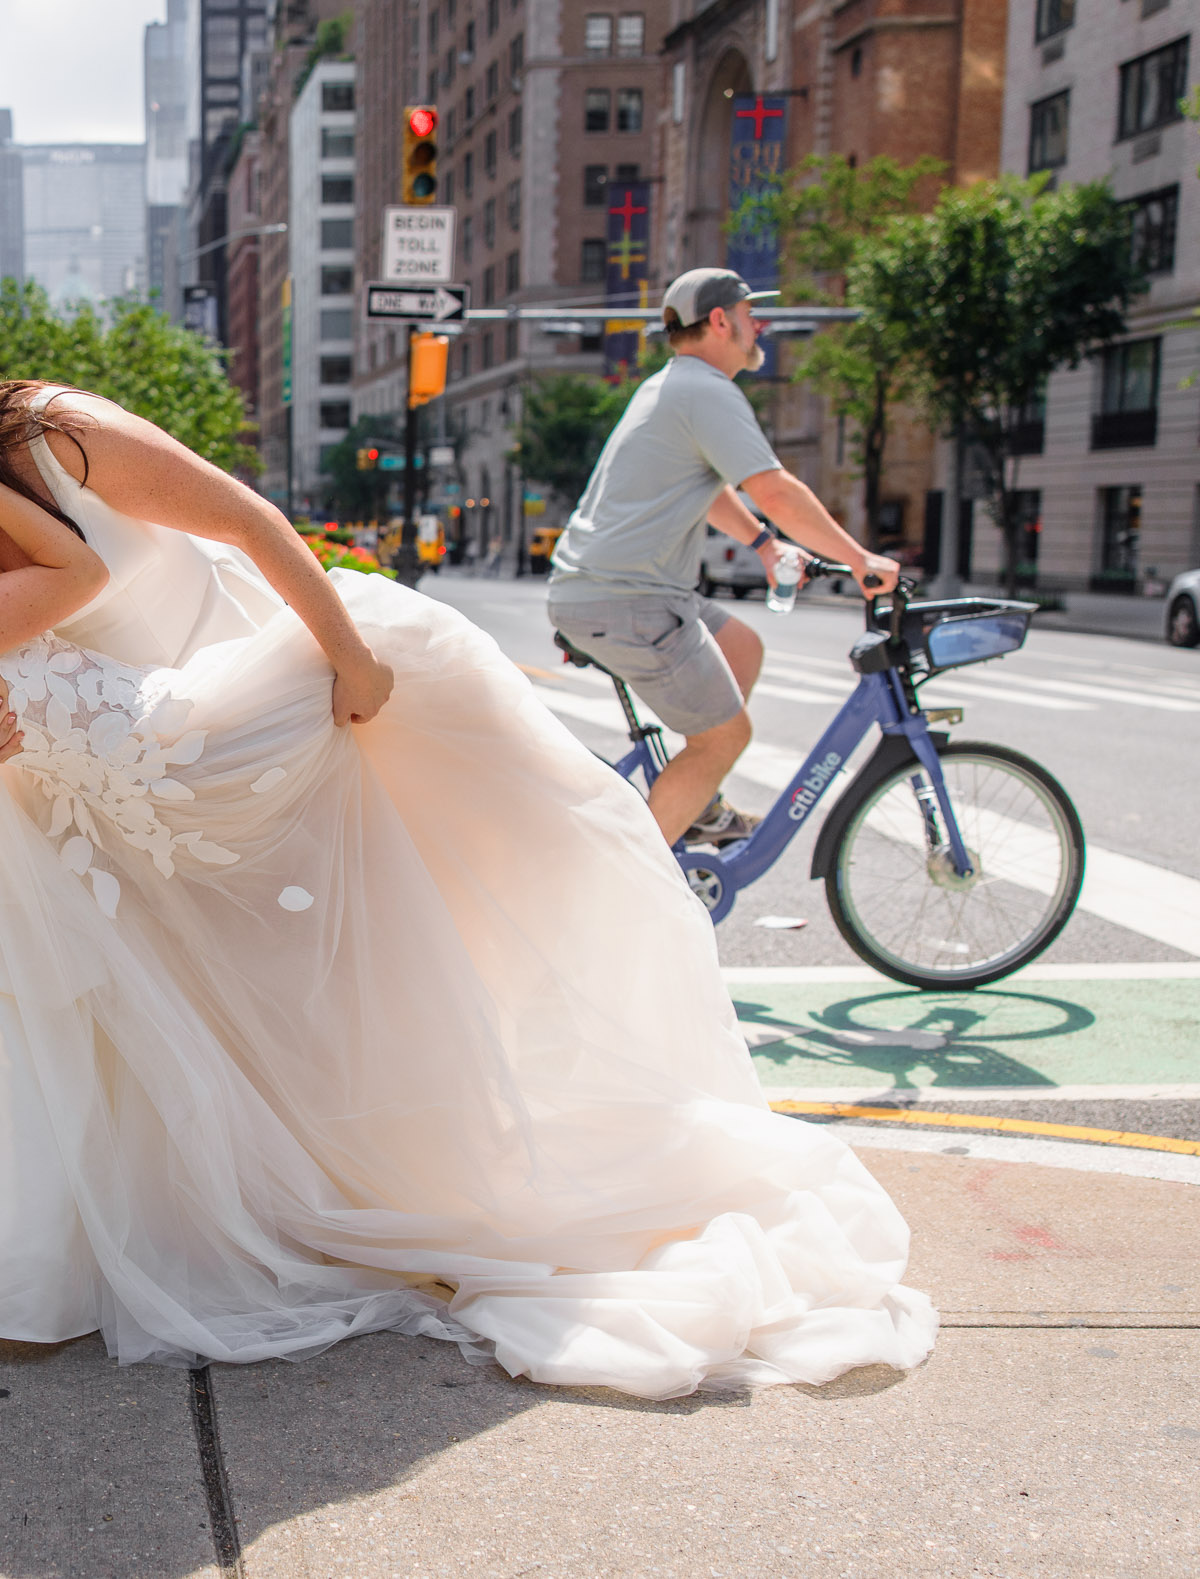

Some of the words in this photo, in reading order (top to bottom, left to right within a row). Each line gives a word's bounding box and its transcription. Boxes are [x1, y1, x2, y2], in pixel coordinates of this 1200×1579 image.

[394, 216, 446, 231] BEGIN
[398, 237, 441, 252] TOLL
[394, 259, 442, 274] ZONE
[377, 295, 402, 309] ONE
[417, 296, 448, 310] WAY
[788, 787, 817, 821] citi
[803, 751, 841, 792] bike
